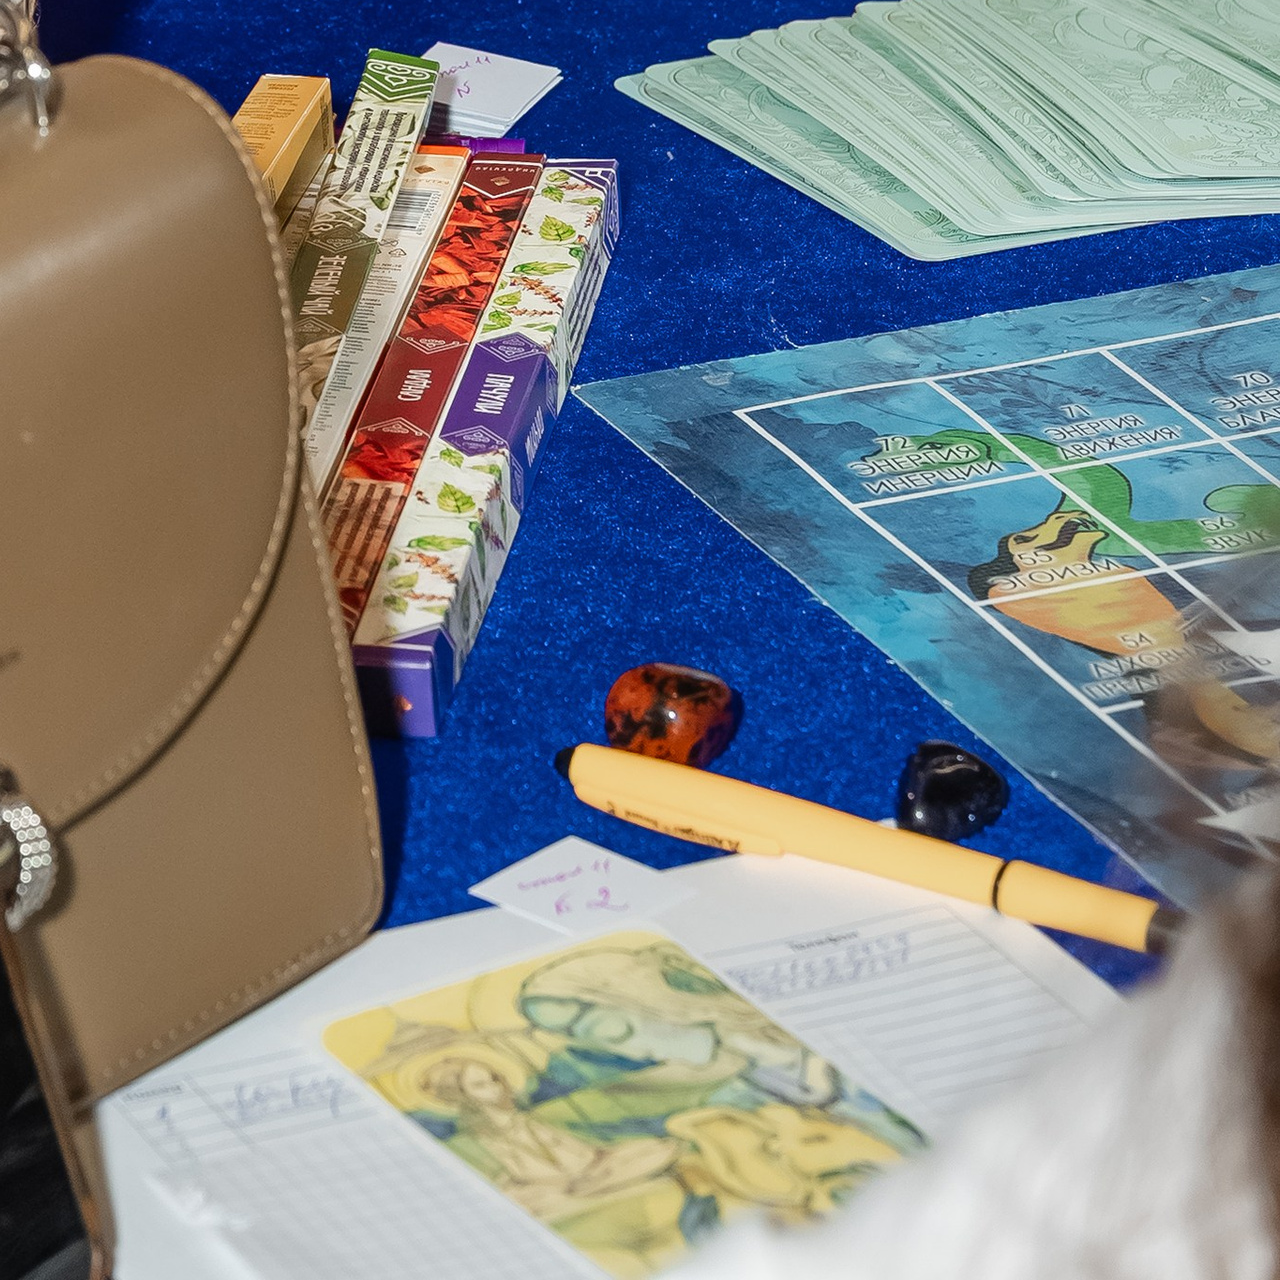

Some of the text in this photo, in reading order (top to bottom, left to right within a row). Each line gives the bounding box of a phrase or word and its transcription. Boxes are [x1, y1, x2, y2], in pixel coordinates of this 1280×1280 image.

[307, 255, 347, 295] ЗЕЛЕНЫЙ
[300, 297, 334, 315] ЧАЙ
[397, 370, 432, 401] САНДАЛ
[1233, 372, 1270, 388] 70
[473, 373, 515, 414] ПАЧУЛИ
[1061, 404, 1090, 419] 71
[1044, 414, 1144, 441] ЭНЕРГИЯ
[875, 436, 914, 452] 72
[1059, 426, 1180, 460] ДВИЖЕНИЯ
[849, 445, 979, 477] ЭНЕРГИЯ
[865, 461, 1004, 494] ИНЕРЦИИ
[1201, 516, 1237, 532] 56
[1204, 528, 1271, 552] ЗВУК
[1017, 550, 1052, 567] 55
[987, 557, 1121, 591] ЭГОИЗМ
[1120, 632, 1153, 647] 54
